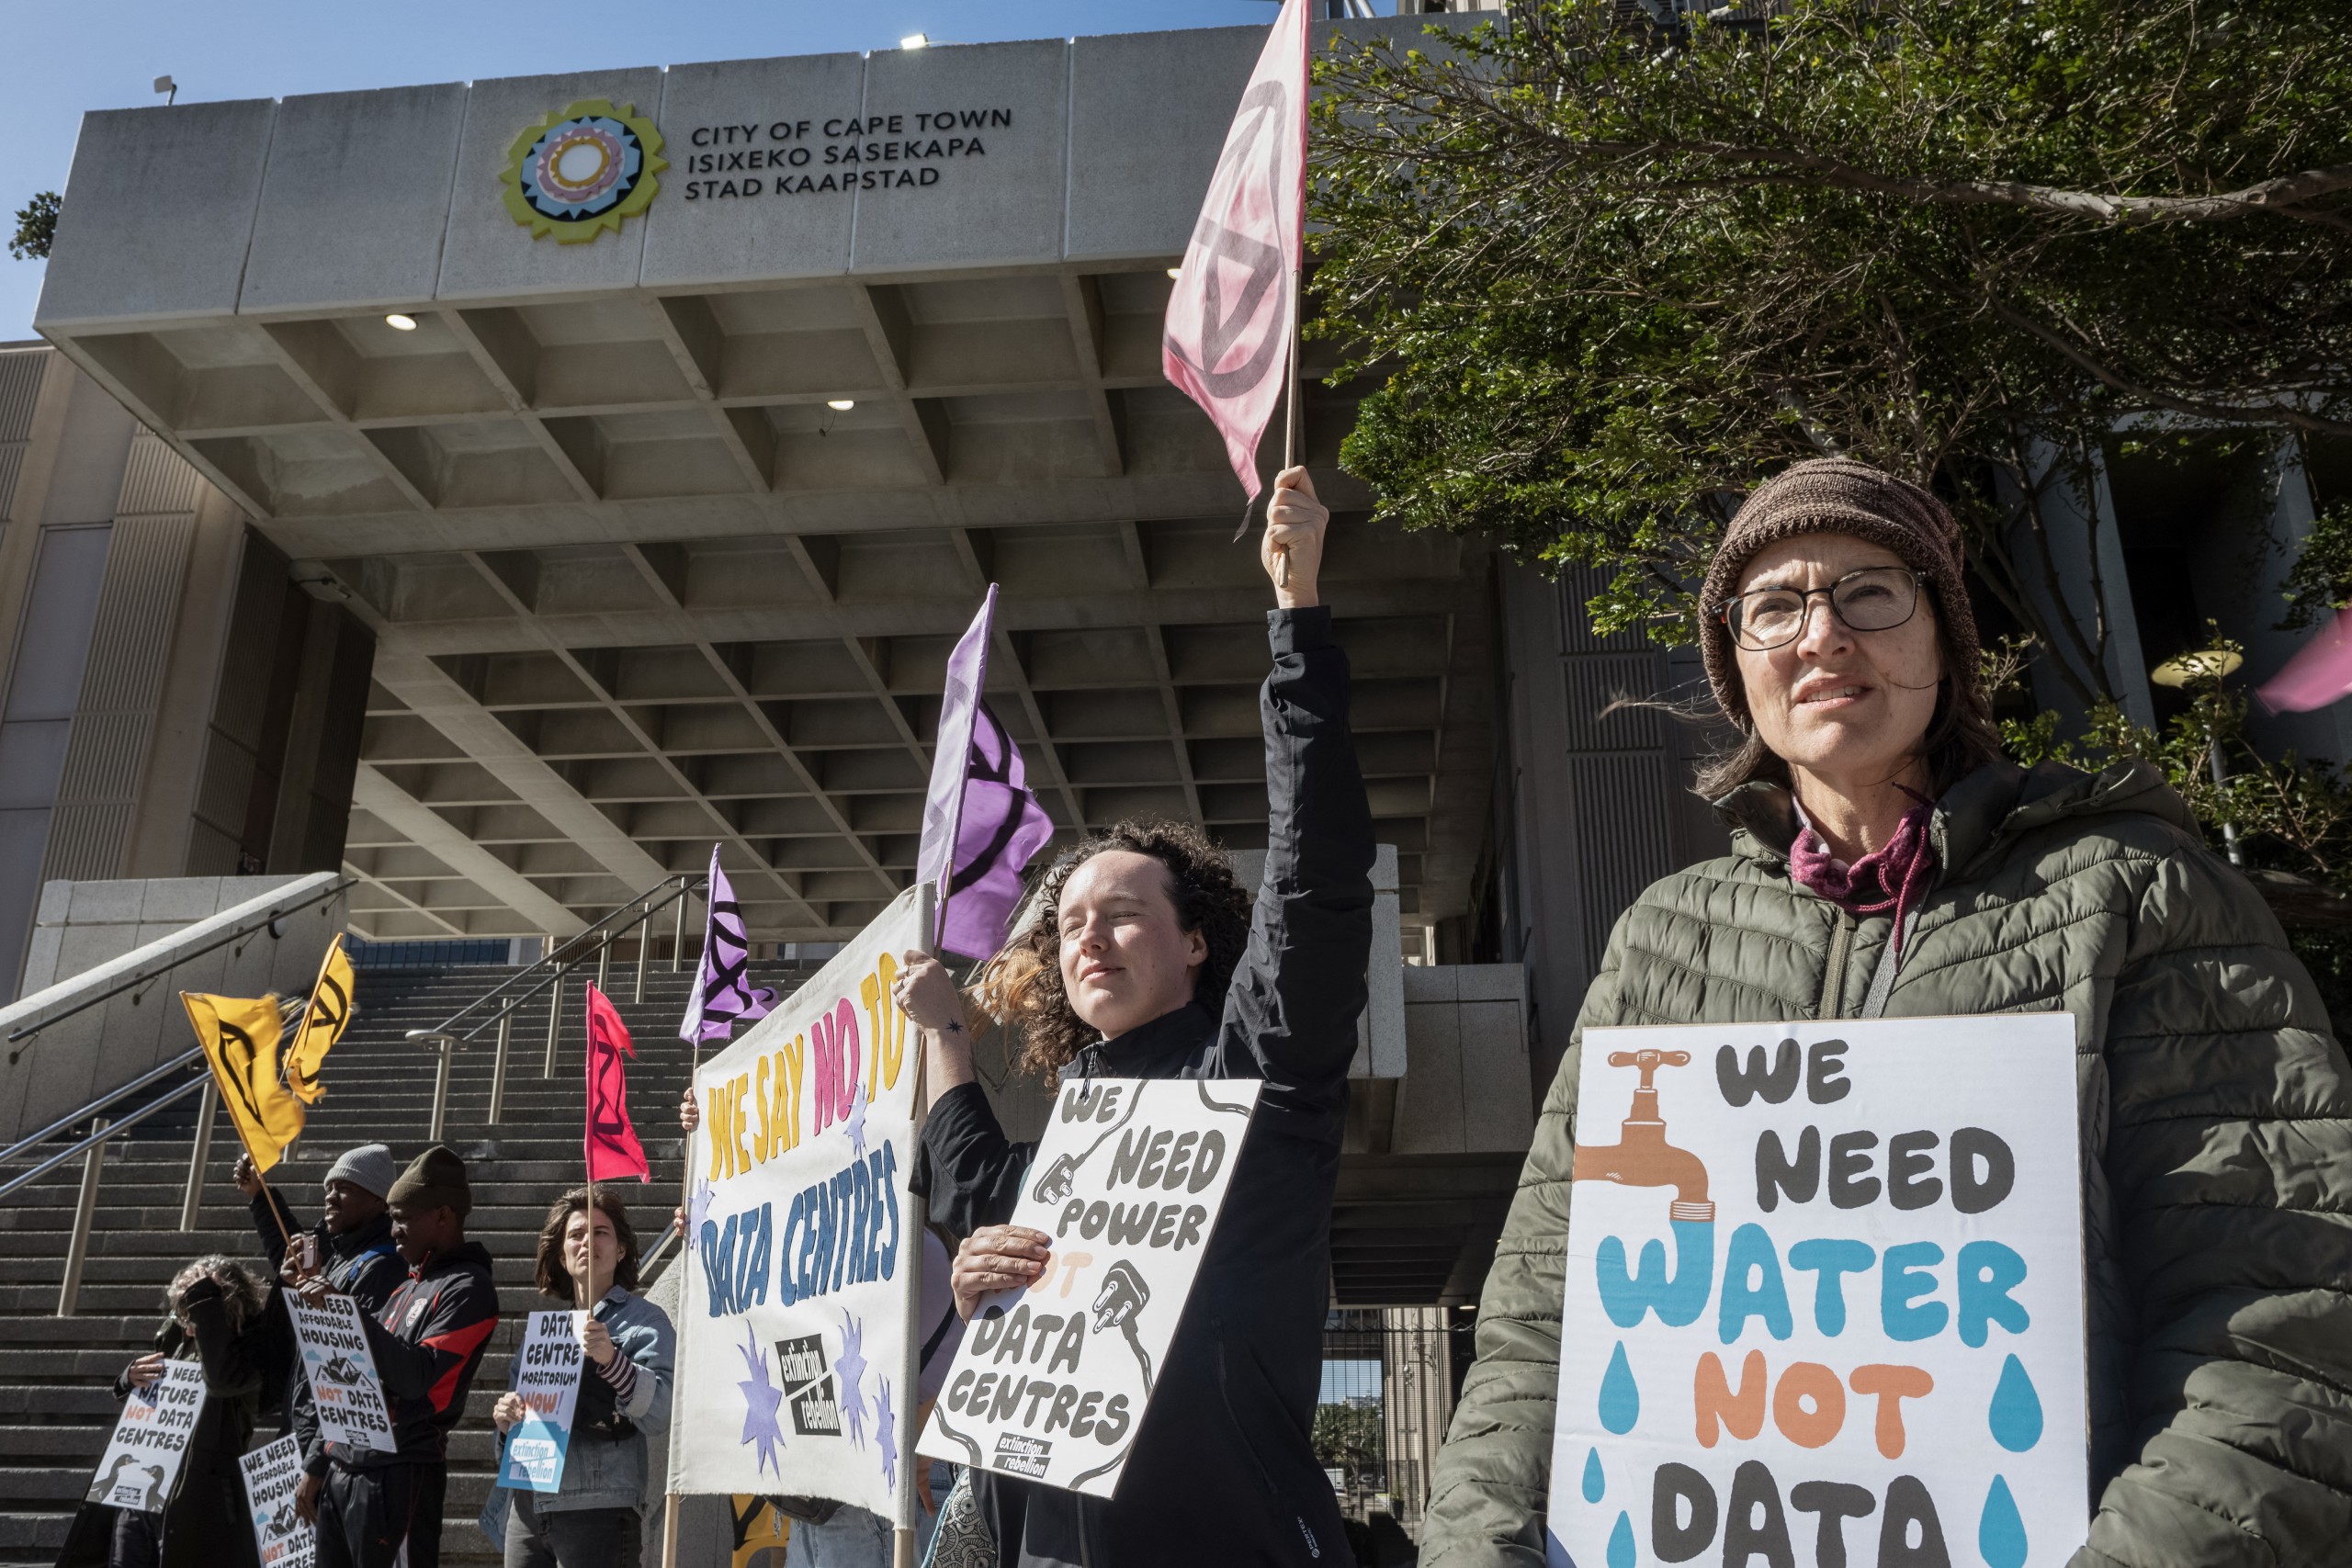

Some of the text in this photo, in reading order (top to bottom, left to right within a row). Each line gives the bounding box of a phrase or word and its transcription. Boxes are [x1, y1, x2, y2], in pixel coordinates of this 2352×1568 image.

[691, 107, 1012, 148] CITY OF CAPE TOWN
[687, 136, 986, 175] ISIXEKO SASEKAPA
[684, 166, 941, 201] STAD KAAPSTAD
[708, 952, 905, 1182] WE SAY NO TO
[1715, 1038, 1851, 1107] WE
[1061, 1086, 1123, 1124] WE
[1106, 1125, 1226, 1194] NEED
[1755, 1125, 2015, 1214] NEED
[700, 1138, 899, 1319] DATA CENTRES
[1057, 1198, 1207, 1251] POWER
[1596, 1220, 2030, 1348] WATER
[299, 1311, 354, 1330] AFFORDABLE
[540, 1312, 574, 1337] DATA
[300, 1327, 364, 1351] HOUSING
[526, 1342, 580, 1367] CENTRE
[970, 1303, 1086, 1374] DATA
[781, 1339, 823, 1382] extinction
[138, 1382, 198, 1405] NATURE
[521, 1371, 577, 1386] MORATORIUM
[317, 1385, 383, 1411] NOT DATA
[525, 1390, 564, 1416] NOW!
[800, 1382, 840, 1430] rebellion
[947, 1369, 1130, 1446] CENTRES
[1693, 1349, 1934, 1460] NOT
[125, 1405, 194, 1429] NOT DATA
[320, 1404, 389, 1433] CENTRES
[116, 1427, 185, 1452] CENTRES
[244, 1438, 296, 1474] WE NEED
[513, 1440, 548, 1458] extinction
[999, 1436, 1044, 1454] extinction
[252, 1459, 295, 1488] AFFORDABLE
[518, 1460, 553, 1480] rebellion
[1004, 1454, 1046, 1476] rebellion
[253, 1472, 301, 1507] HOUSING
[1652, 1461, 1952, 1568] DATA
[264, 1529, 315, 1563] NOT DATA
